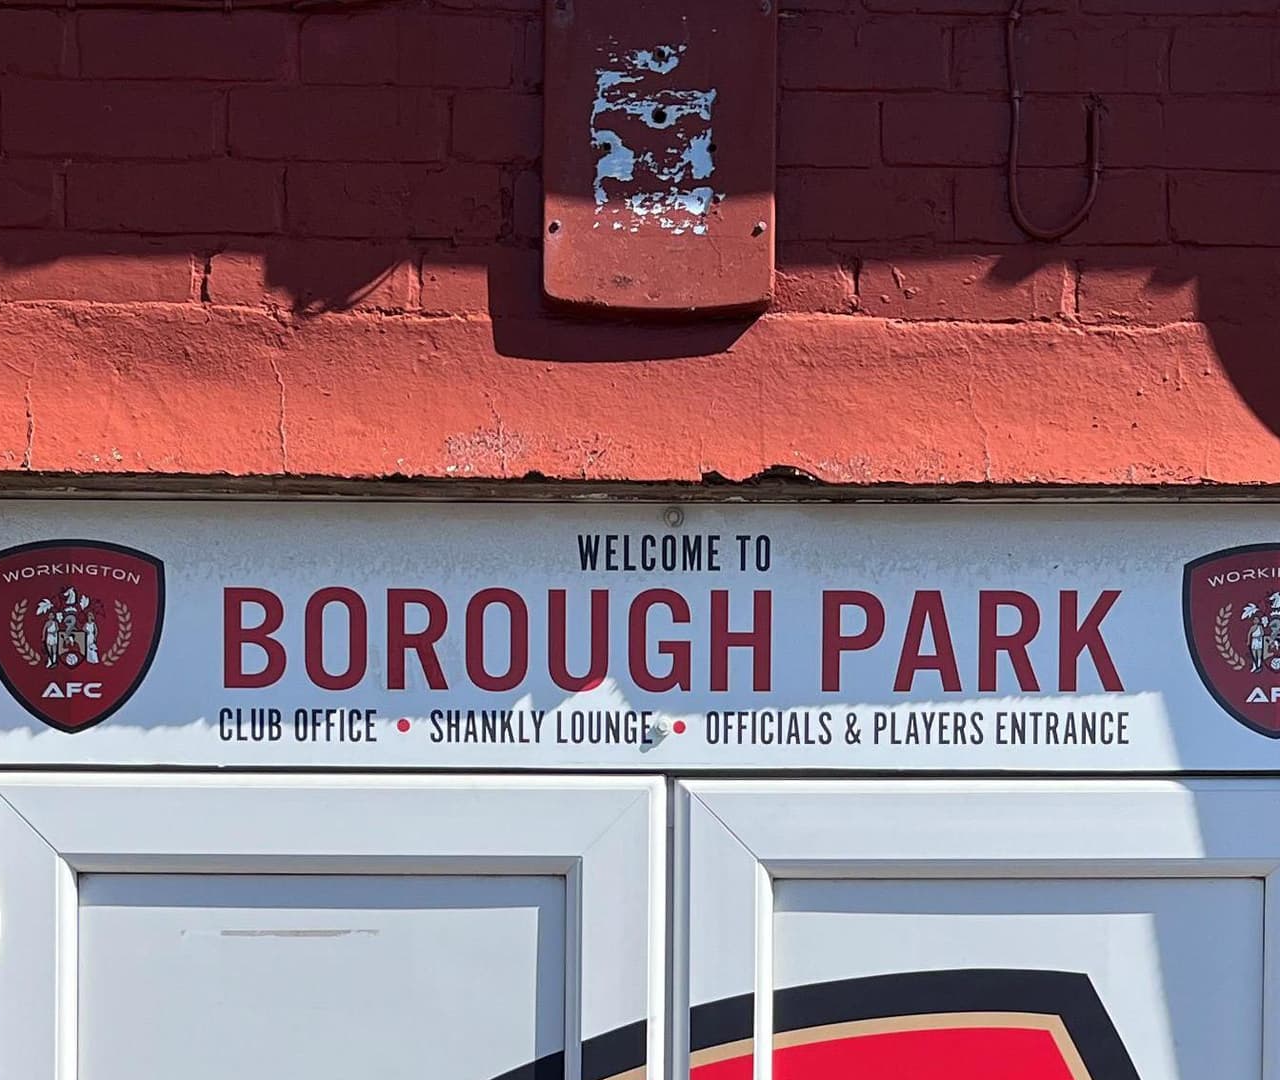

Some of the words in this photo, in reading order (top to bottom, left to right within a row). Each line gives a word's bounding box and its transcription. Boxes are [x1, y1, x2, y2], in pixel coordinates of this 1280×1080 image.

[577, 534, 722, 572] WELCOME
[737, 534, 772, 572] TO
[1, 564, 141, 585] WORKINGTON
[222, 586, 773, 694] BOROUGH
[821, 589, 1126, 693] PARK
[41, 682, 103, 699] AFC
[219, 709, 283, 743] CLUB
[294, 709, 377, 743] OFFICE
[429, 709, 545, 743] SHANKLY
[556, 709, 654, 744] LOUNGE
[706, 711, 833, 745] OFFICIALS
[845, 711, 862, 745] &
[873, 711, 985, 745] PLAYERS
[996, 711, 1130, 745] ENTRANCE
